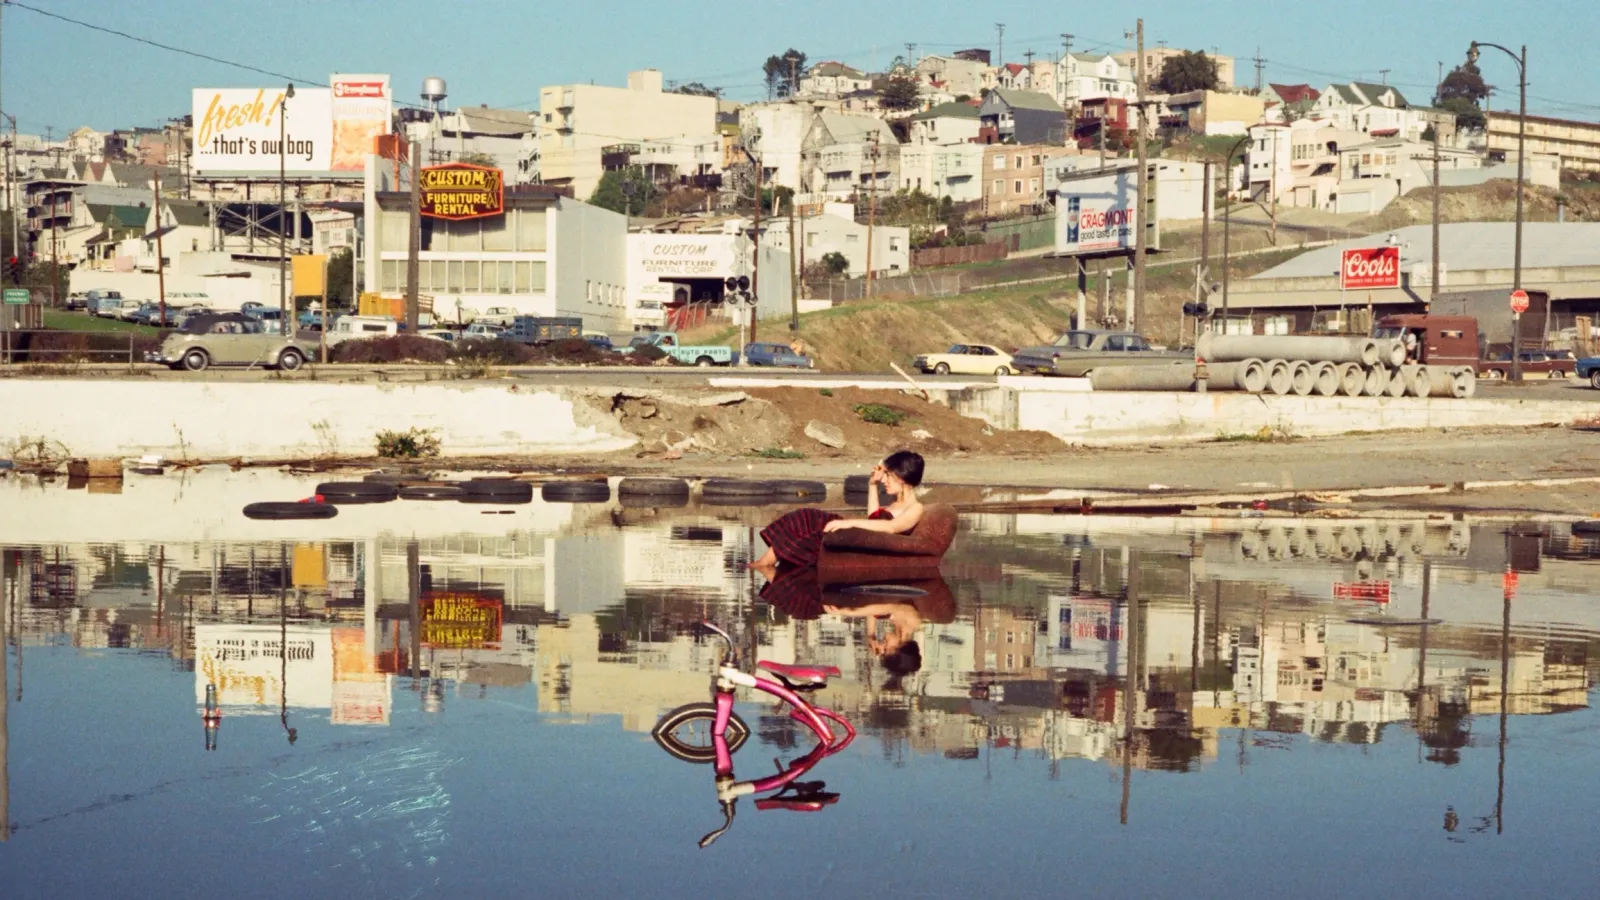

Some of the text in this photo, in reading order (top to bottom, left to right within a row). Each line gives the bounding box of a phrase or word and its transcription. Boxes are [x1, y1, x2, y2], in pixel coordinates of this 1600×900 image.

[198, 88, 284, 147] fresh!
[287, 134, 313, 161] bag
[427, 171, 485, 186] CUSTOM
[427, 192, 487, 204] FURNITURE
[435, 204, 477, 215] RENTAL
[1081, 208, 1133, 230] CRAGMONT
[1080, 231, 1096, 242] good
[653, 244, 708, 256] CUSTOM
[642, 259, 717, 267] FURNITURE
[1346, 252, 1395, 277] Coors
[646, 266, 681, 274] RENTAL
